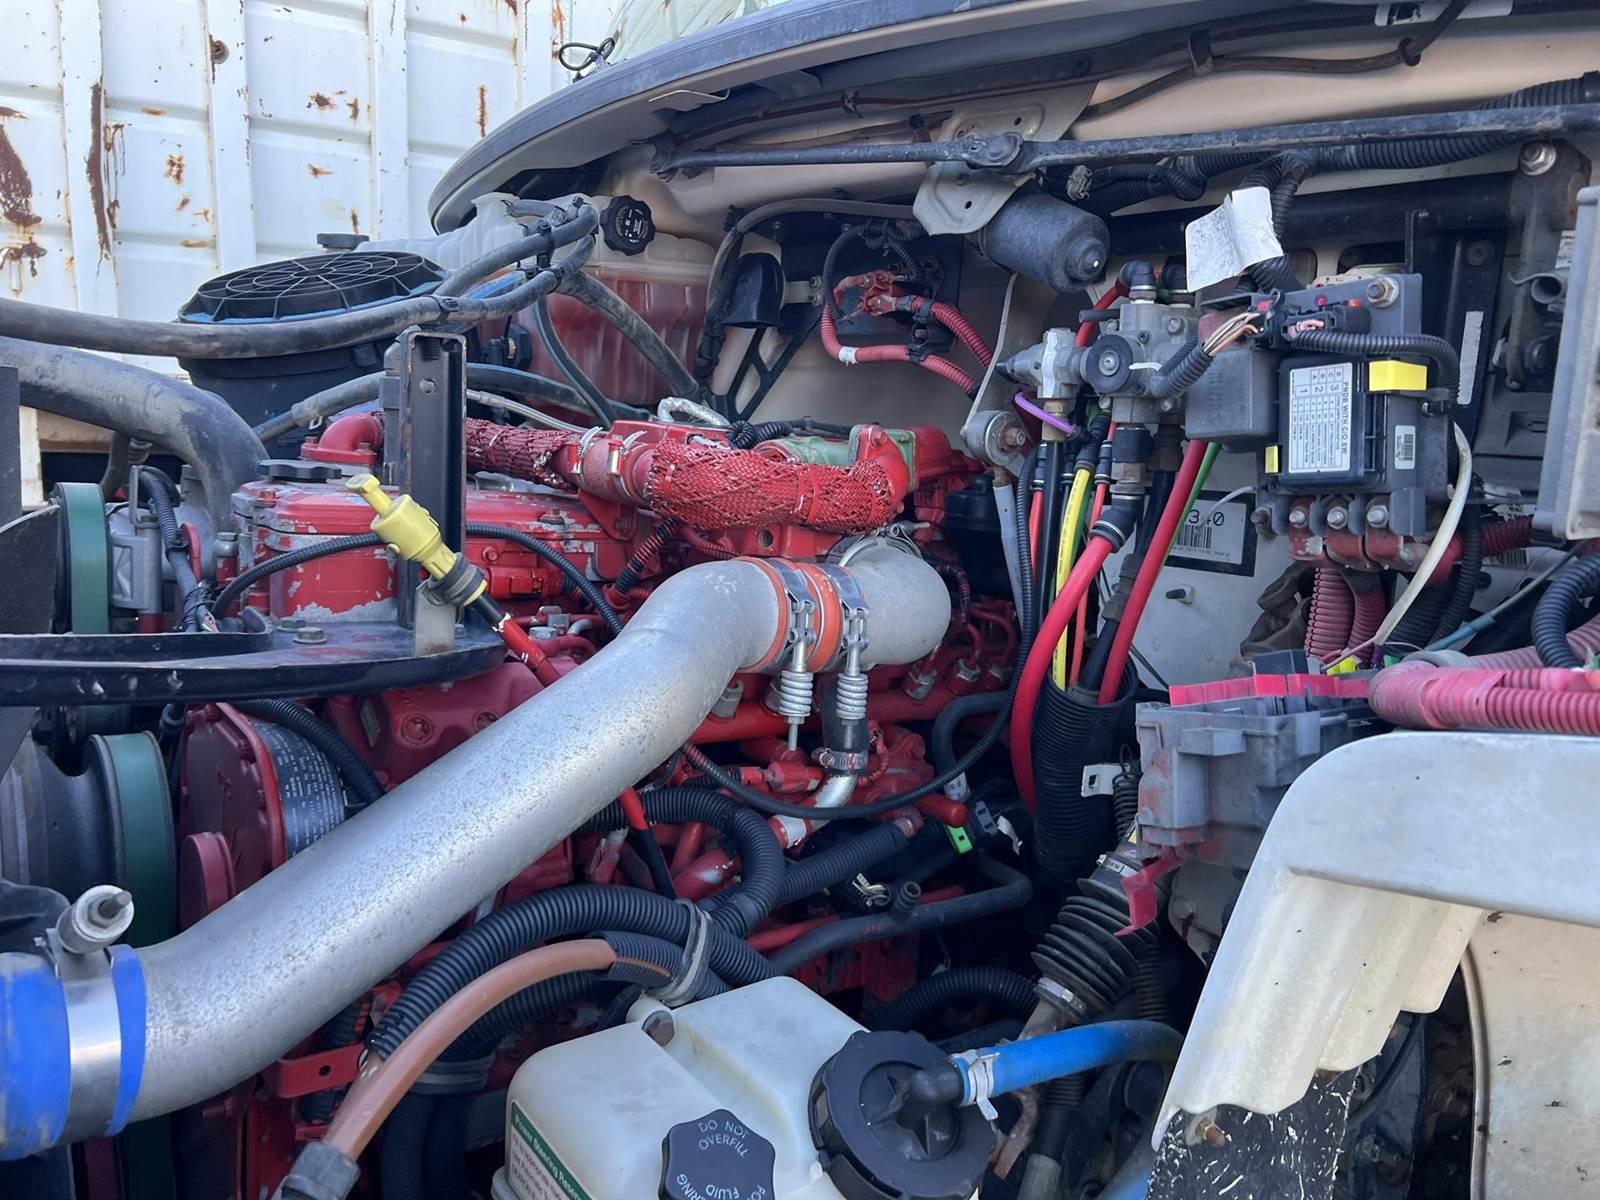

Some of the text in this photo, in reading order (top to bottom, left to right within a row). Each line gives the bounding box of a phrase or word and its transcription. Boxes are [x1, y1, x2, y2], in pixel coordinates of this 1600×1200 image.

[1341, 442, 1348, 454] SW
[698, 1120, 747, 1138] DO NOT
[698, 1133, 749, 1158] OVERFILL
[705, 1184, 740, 1200] FLUID
